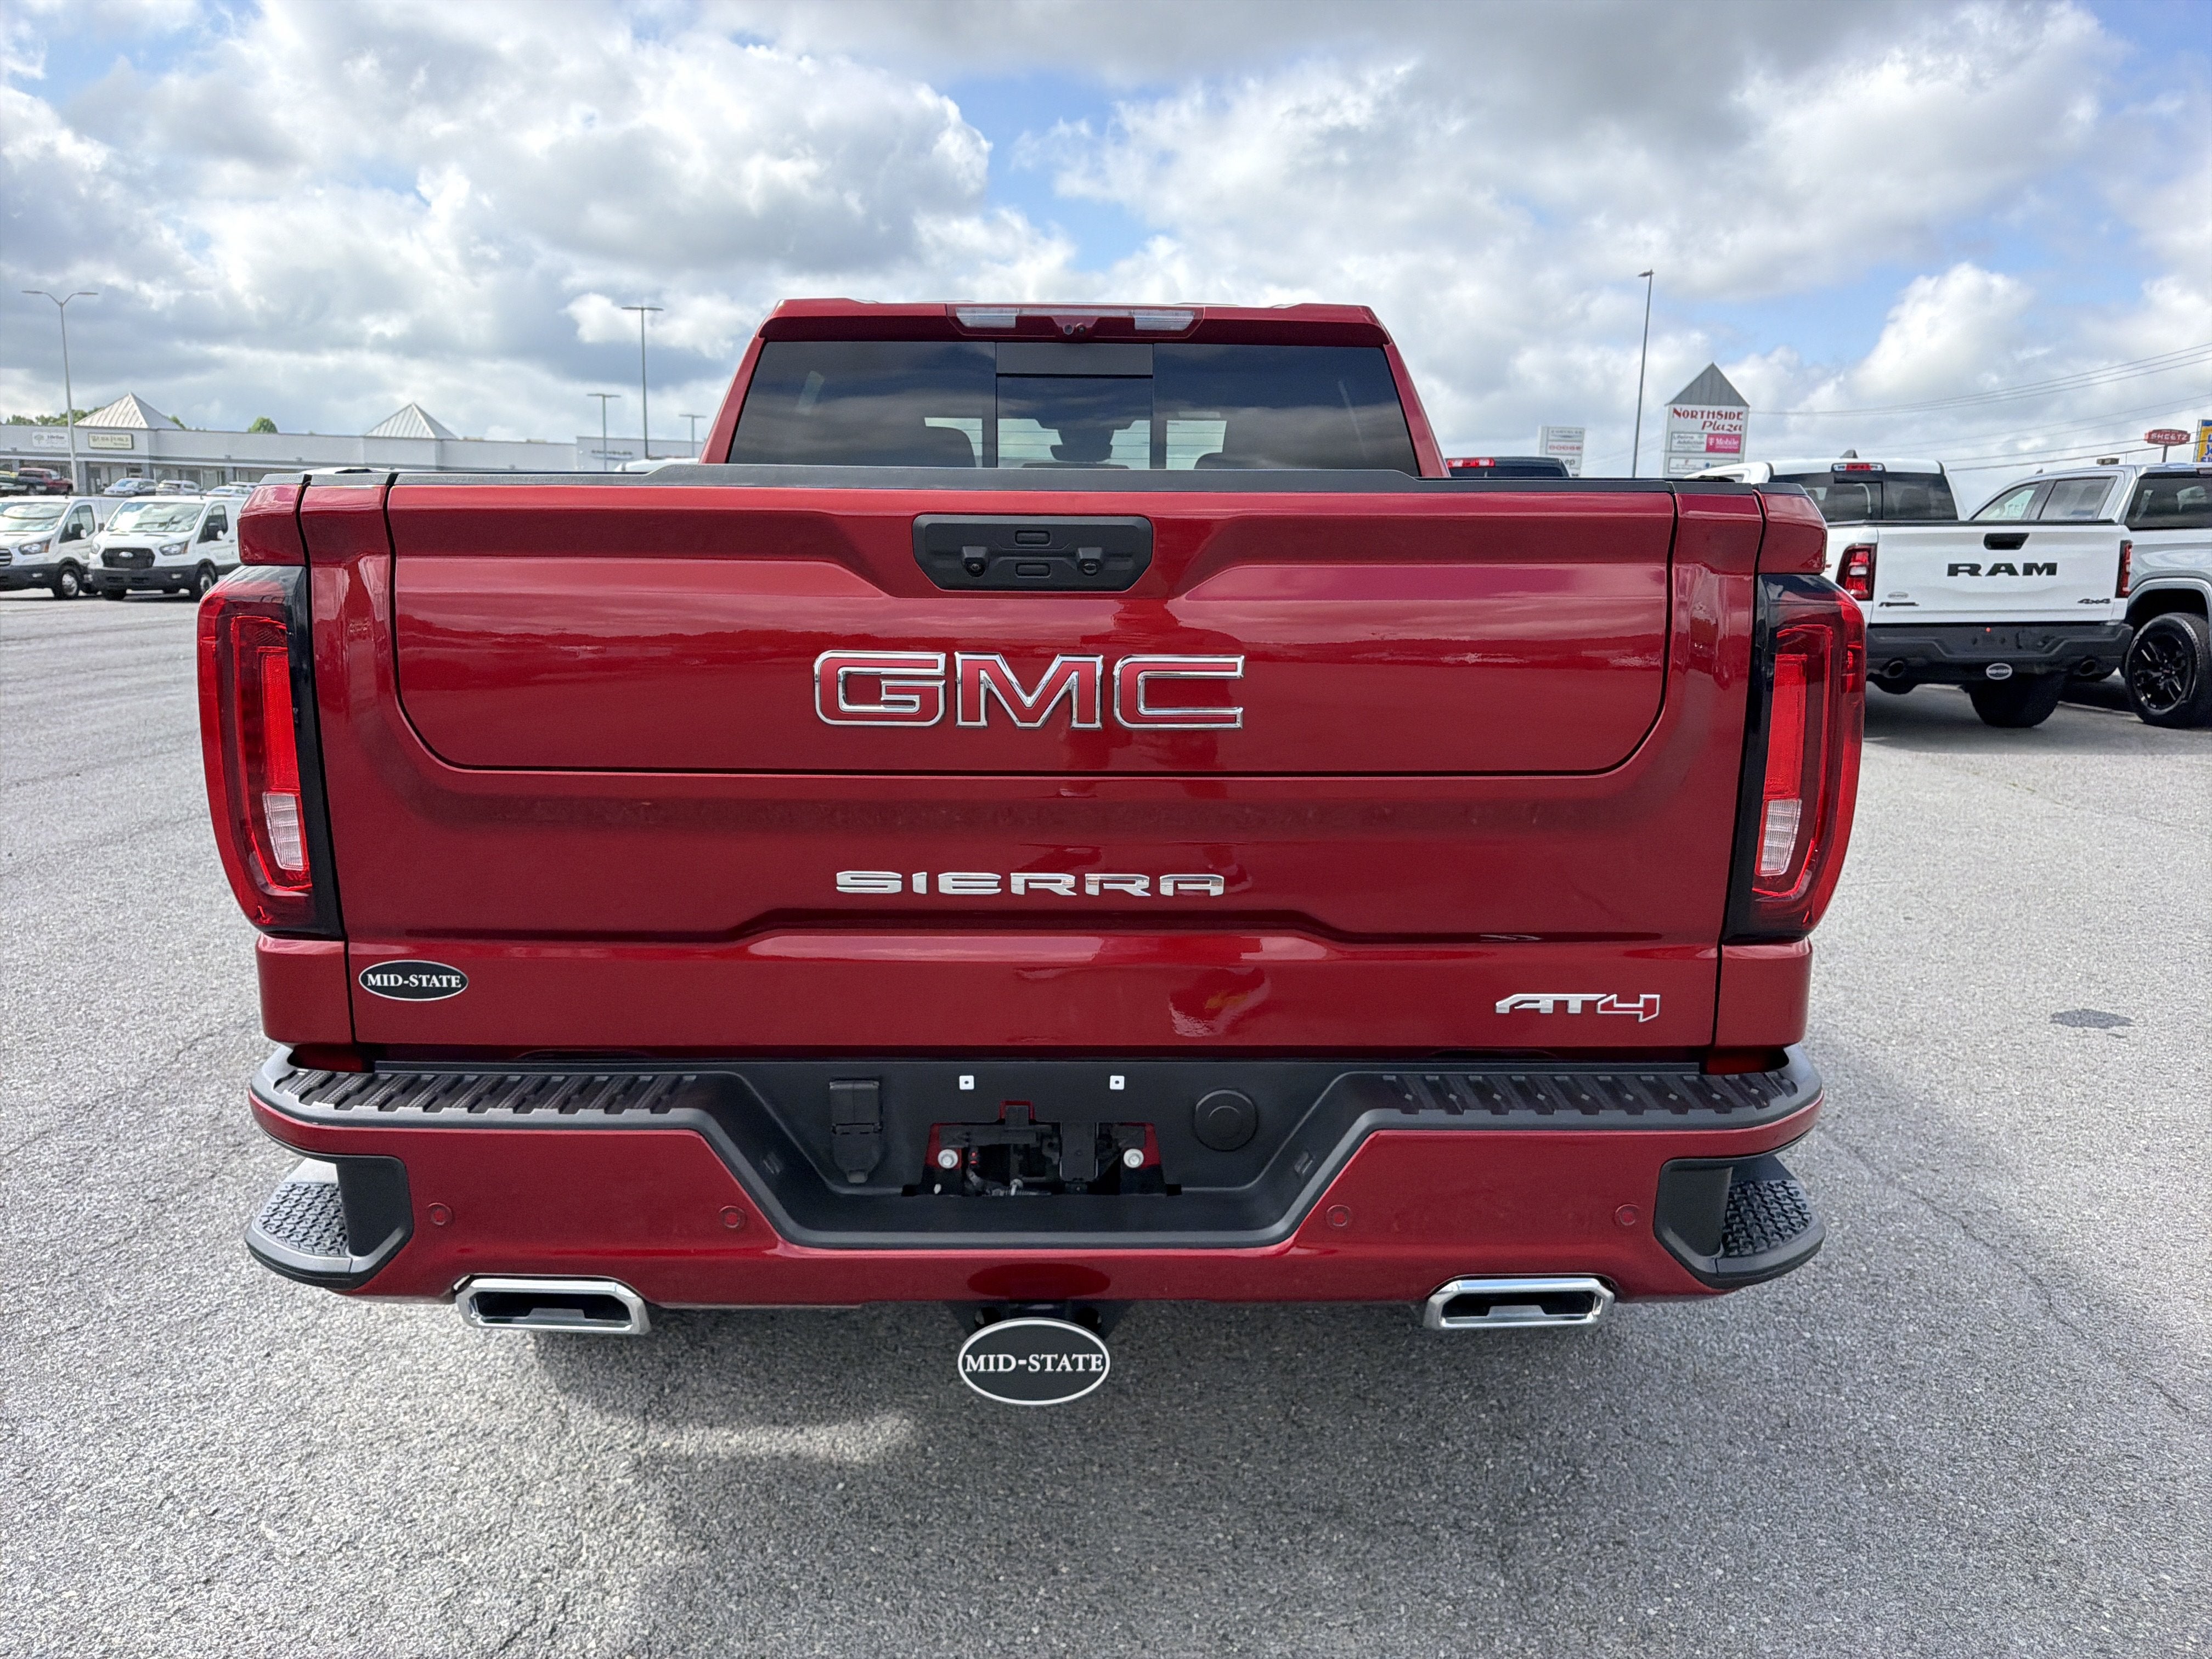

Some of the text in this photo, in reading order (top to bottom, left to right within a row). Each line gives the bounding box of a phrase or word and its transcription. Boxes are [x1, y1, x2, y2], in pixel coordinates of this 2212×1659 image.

[1672, 408, 1743, 421] NORTHSIDE
[1701, 420, 1743, 432] Plaza
[2151, 432, 2187, 441] SHEETZ
[1947, 562, 2058, 577] RAM
[813, 650, 1245, 730] GMC
[836, 870, 1224, 897] SIERRA
[366, 973, 462, 989] MID-STATE
[1495, 993, 1661, 1022] AT4
[964, 1352, 1104, 1374] MID-STATE
